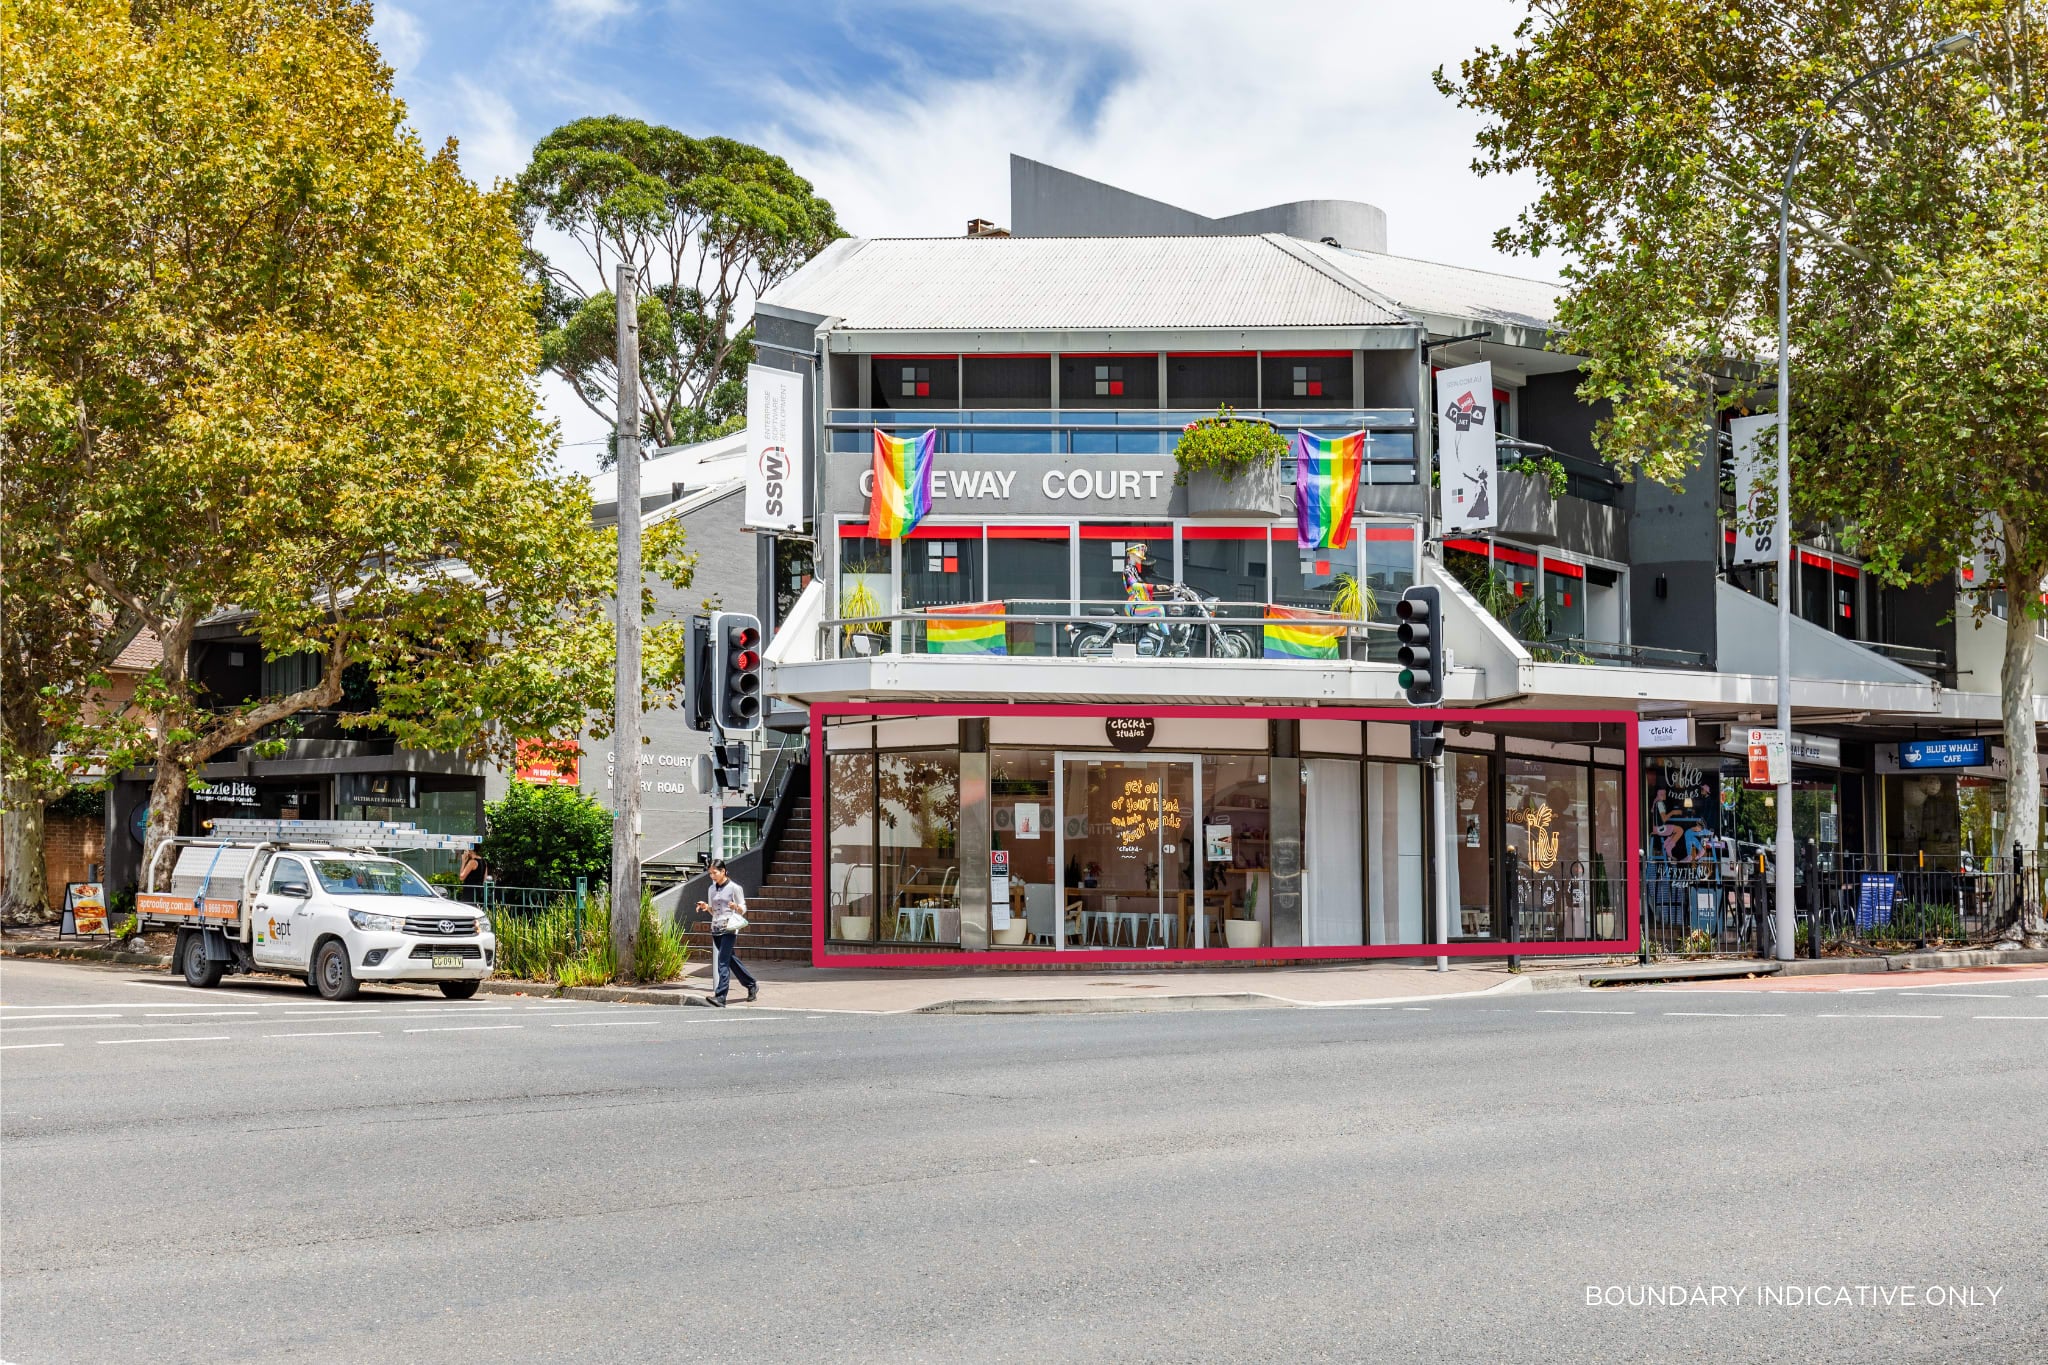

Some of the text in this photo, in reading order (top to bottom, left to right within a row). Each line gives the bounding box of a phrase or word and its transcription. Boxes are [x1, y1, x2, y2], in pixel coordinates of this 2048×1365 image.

[779, 384, 787, 442] DEVELOPMENT
[765, 455, 783, 517] SSW
[859, 469, 1163, 499] GEWAY COURT
[1116, 729, 1145, 738] studios
[1926, 743, 1979, 754] BLUE WHALE
[659, 754, 692, 767] COURT
[1943, 754, 1962, 763] CAFE
[232, 782, 257, 796] Bite
[657, 782, 685, 794] ROAD
[1125, 780, 1142, 796] get
[1111, 796, 1124, 810] of
[1126, 798, 1151, 814] your
[276, 919, 291, 940] apt
